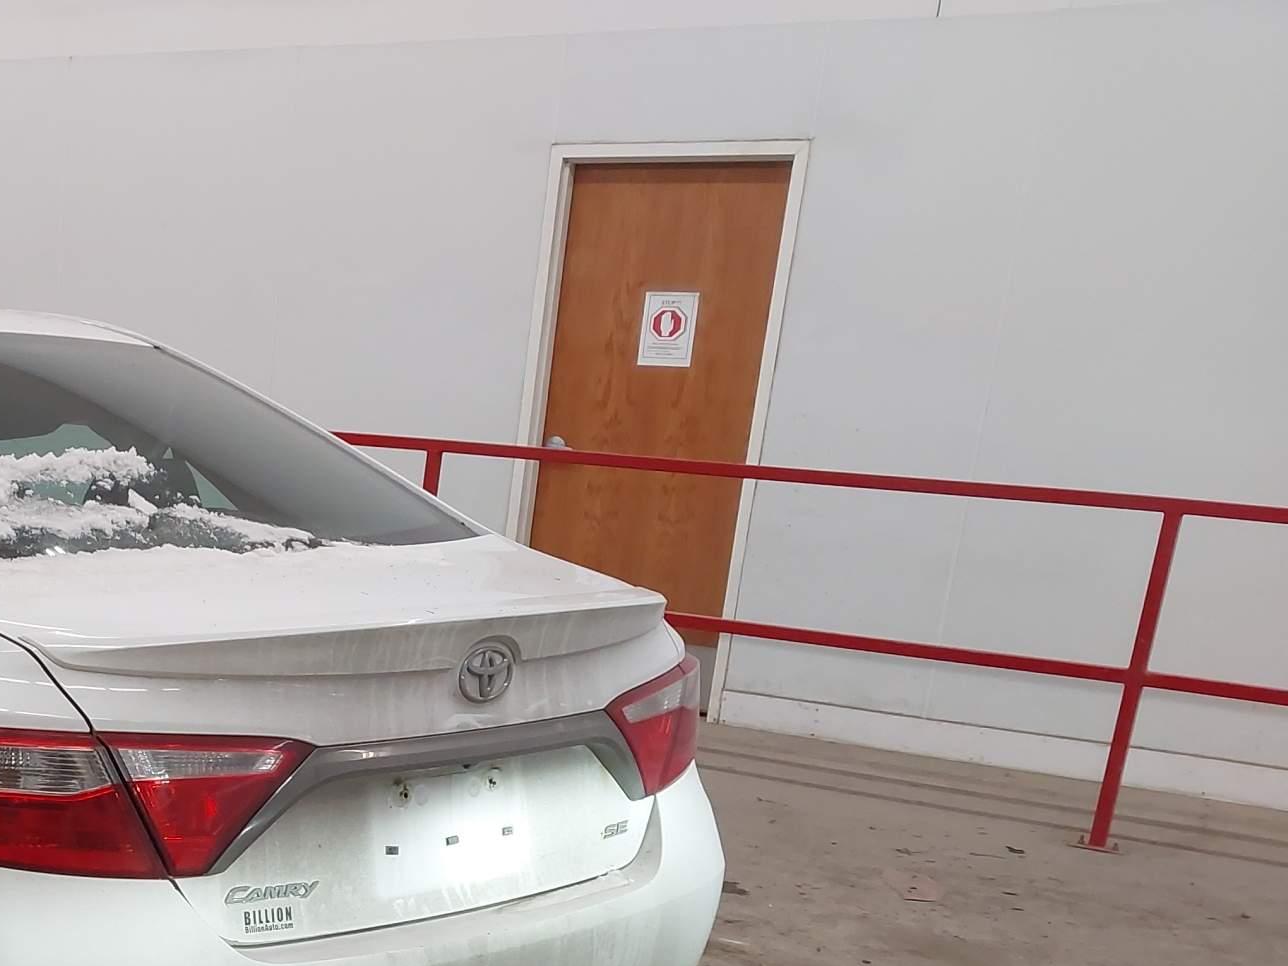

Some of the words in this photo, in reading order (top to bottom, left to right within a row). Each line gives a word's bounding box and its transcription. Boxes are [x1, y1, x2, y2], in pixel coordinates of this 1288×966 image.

[603, 819, 629, 840] SE
[224, 880, 320, 905] CAMRY
[244, 906, 293, 926] BILLION
